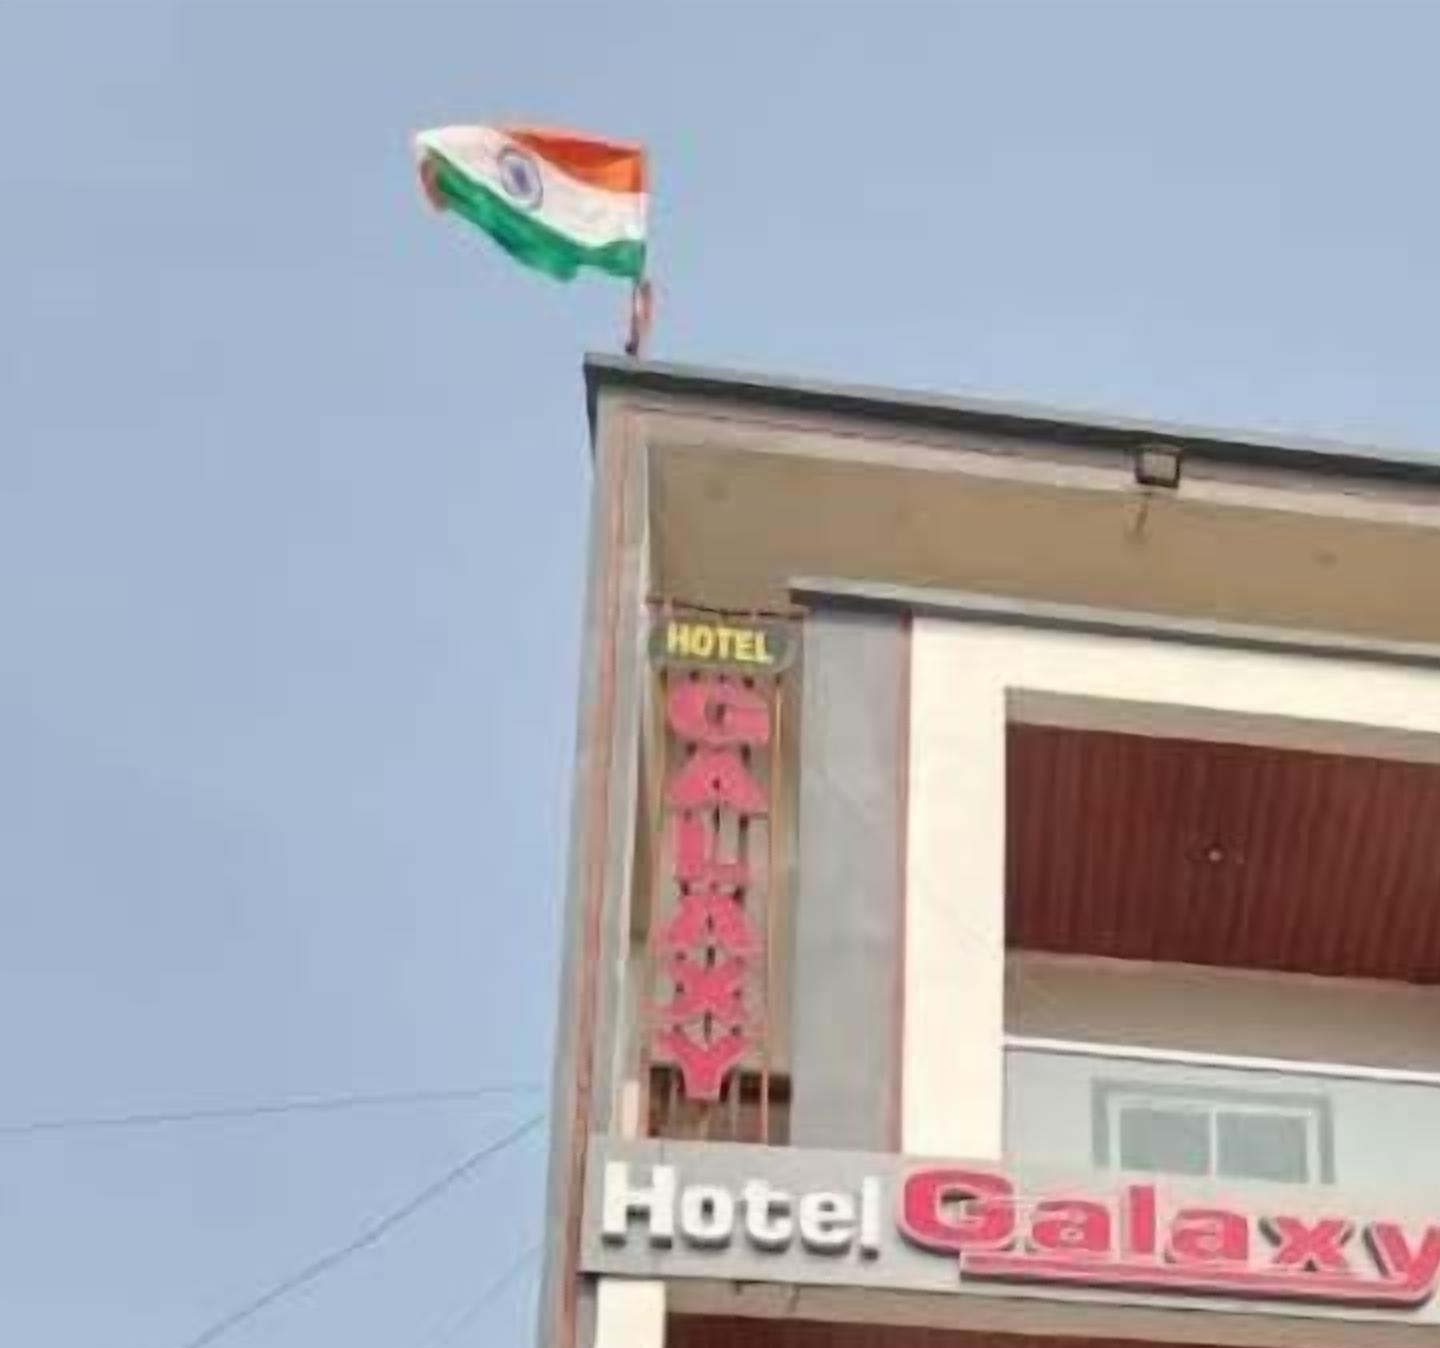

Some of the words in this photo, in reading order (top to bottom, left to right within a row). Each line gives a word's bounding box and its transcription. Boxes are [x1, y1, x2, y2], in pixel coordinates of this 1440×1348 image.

[666, 622, 774, 664] HOTEL
[653, 680, 771, 1099] GALAXY
[601, 1160, 880, 1258] Hotel
